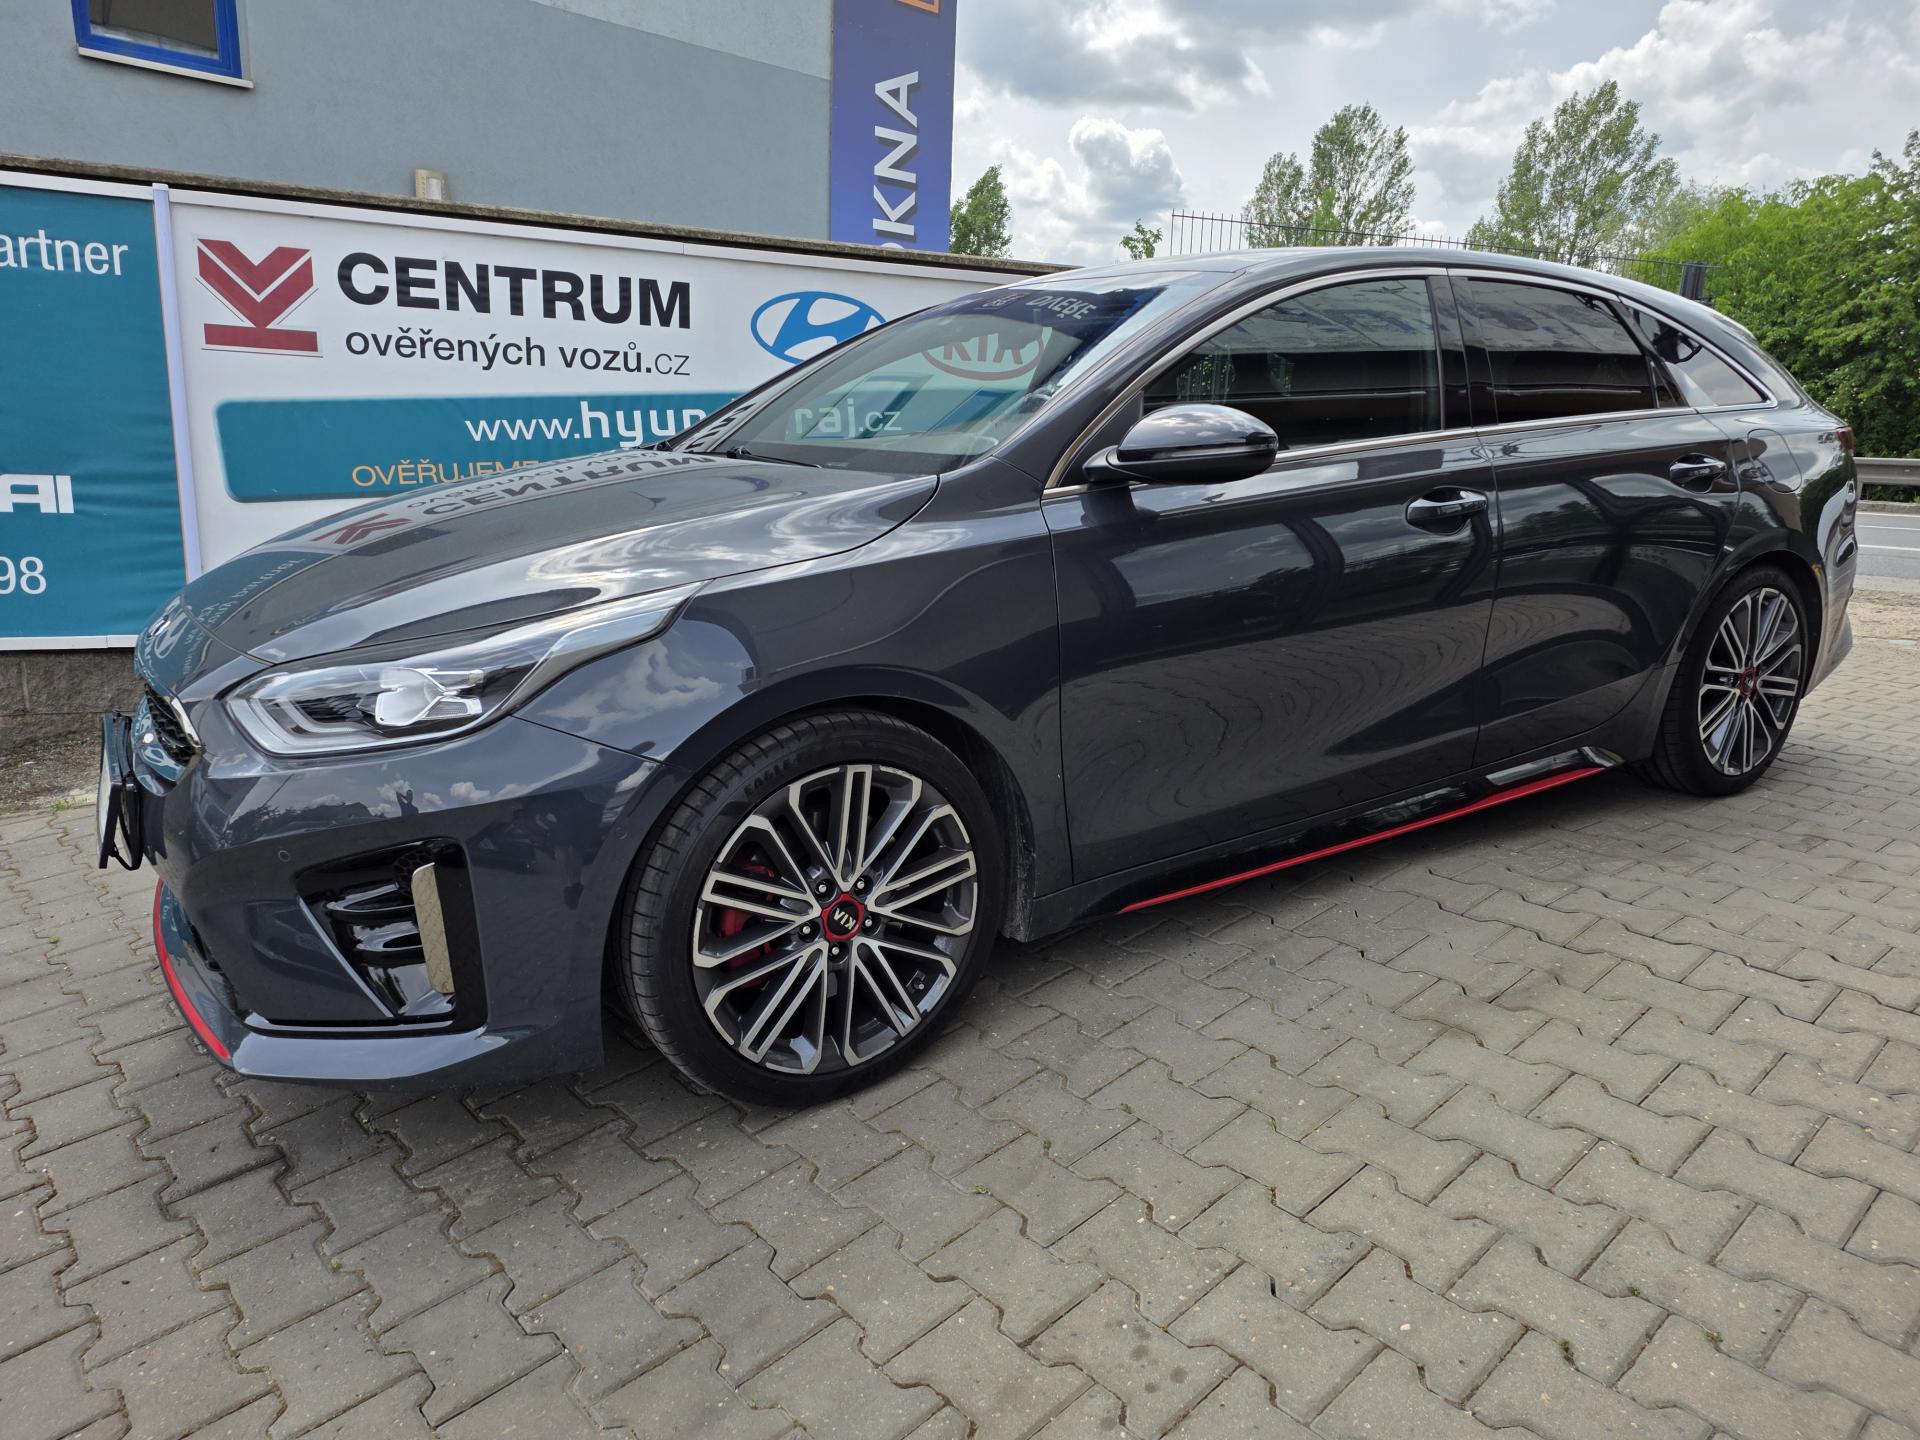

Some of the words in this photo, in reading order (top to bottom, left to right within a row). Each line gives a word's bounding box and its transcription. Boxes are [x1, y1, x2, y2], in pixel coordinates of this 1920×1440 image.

[873, 71, 918, 249] KNA
[0, 229, 129, 276] artner
[337, 252, 691, 330] CENTRUM
[345, 327, 546, 371] ověřených
[0, 474, 75, 514] AI
[833, 907, 857, 930] KIA
